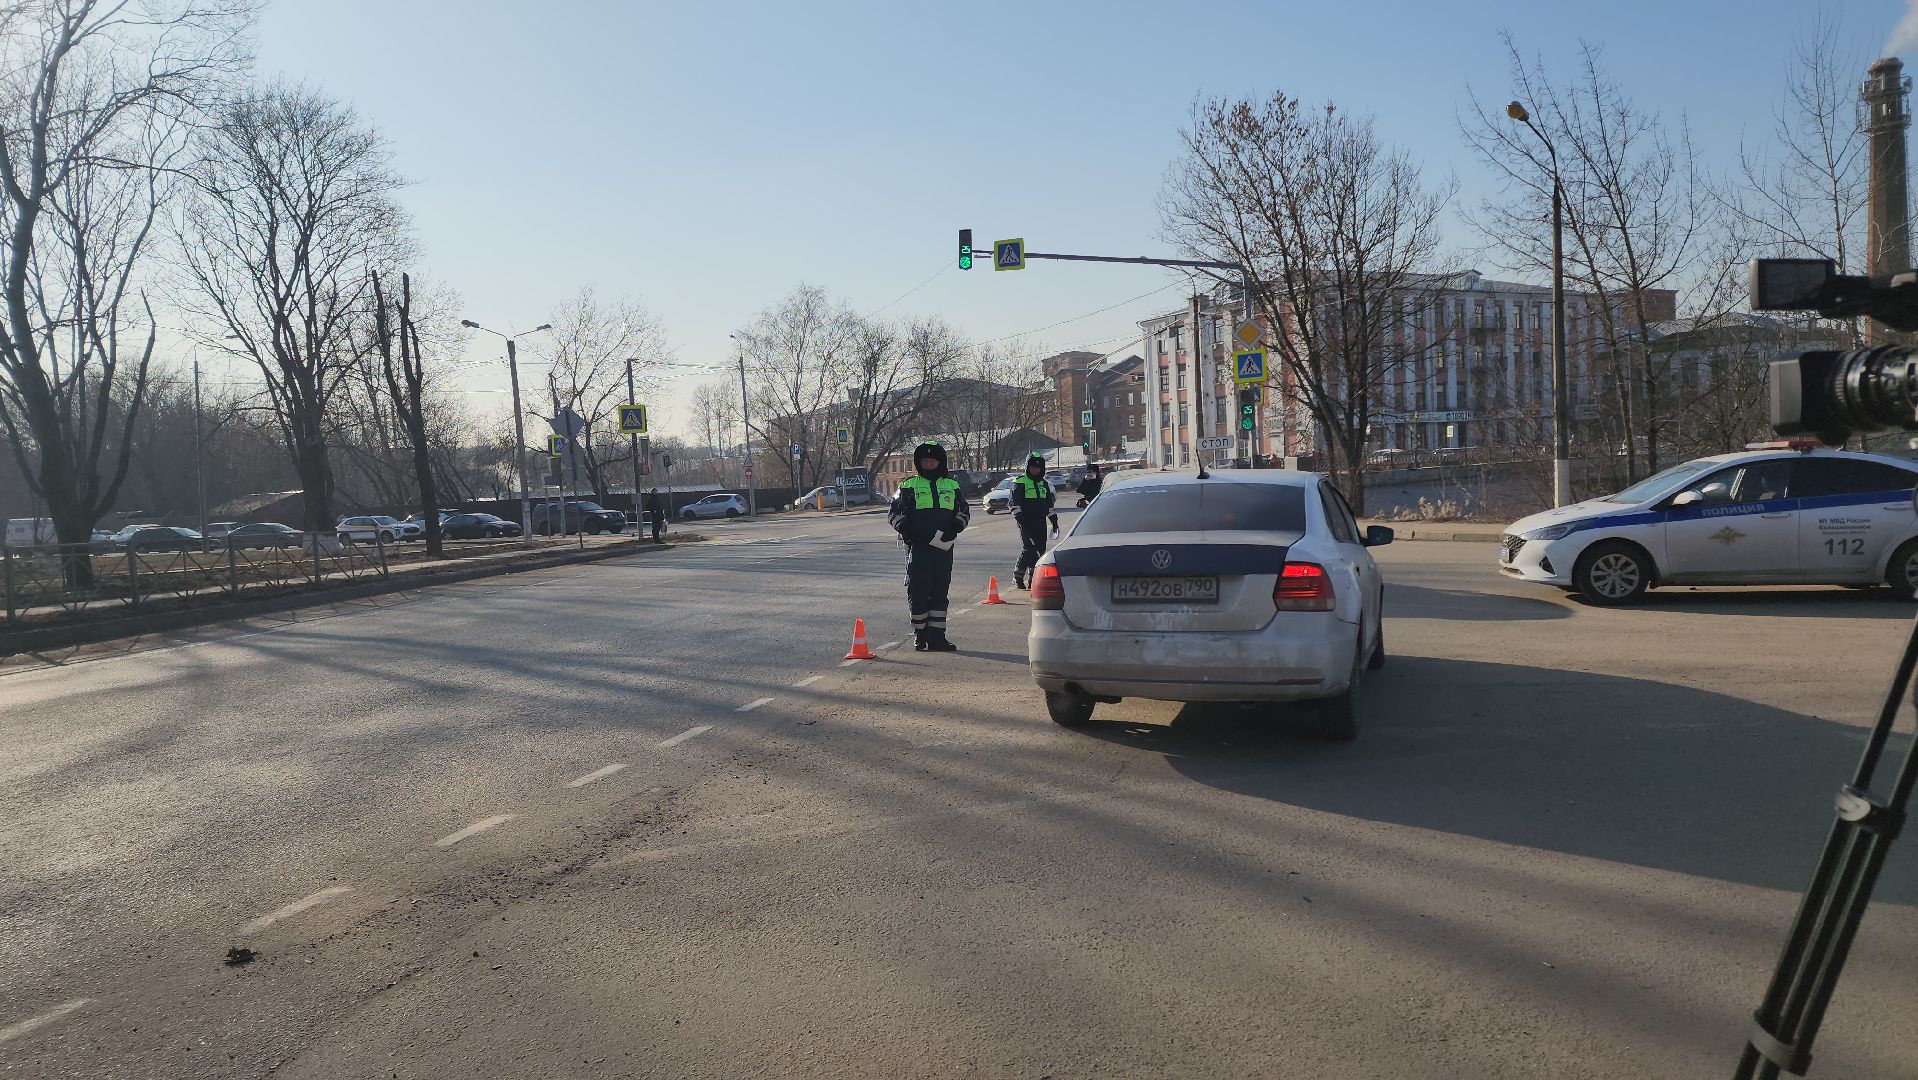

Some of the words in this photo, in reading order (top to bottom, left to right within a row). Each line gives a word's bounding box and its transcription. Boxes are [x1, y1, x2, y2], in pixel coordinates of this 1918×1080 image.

[1201, 438, 1230, 449] СТОП
[1702, 504, 1765, 516] ПОЛИЦИЯ
[1825, 538, 1865, 555] 112
[1119, 581, 1183, 597] Н492ОВ
[1187, 579, 1213, 592] 790
